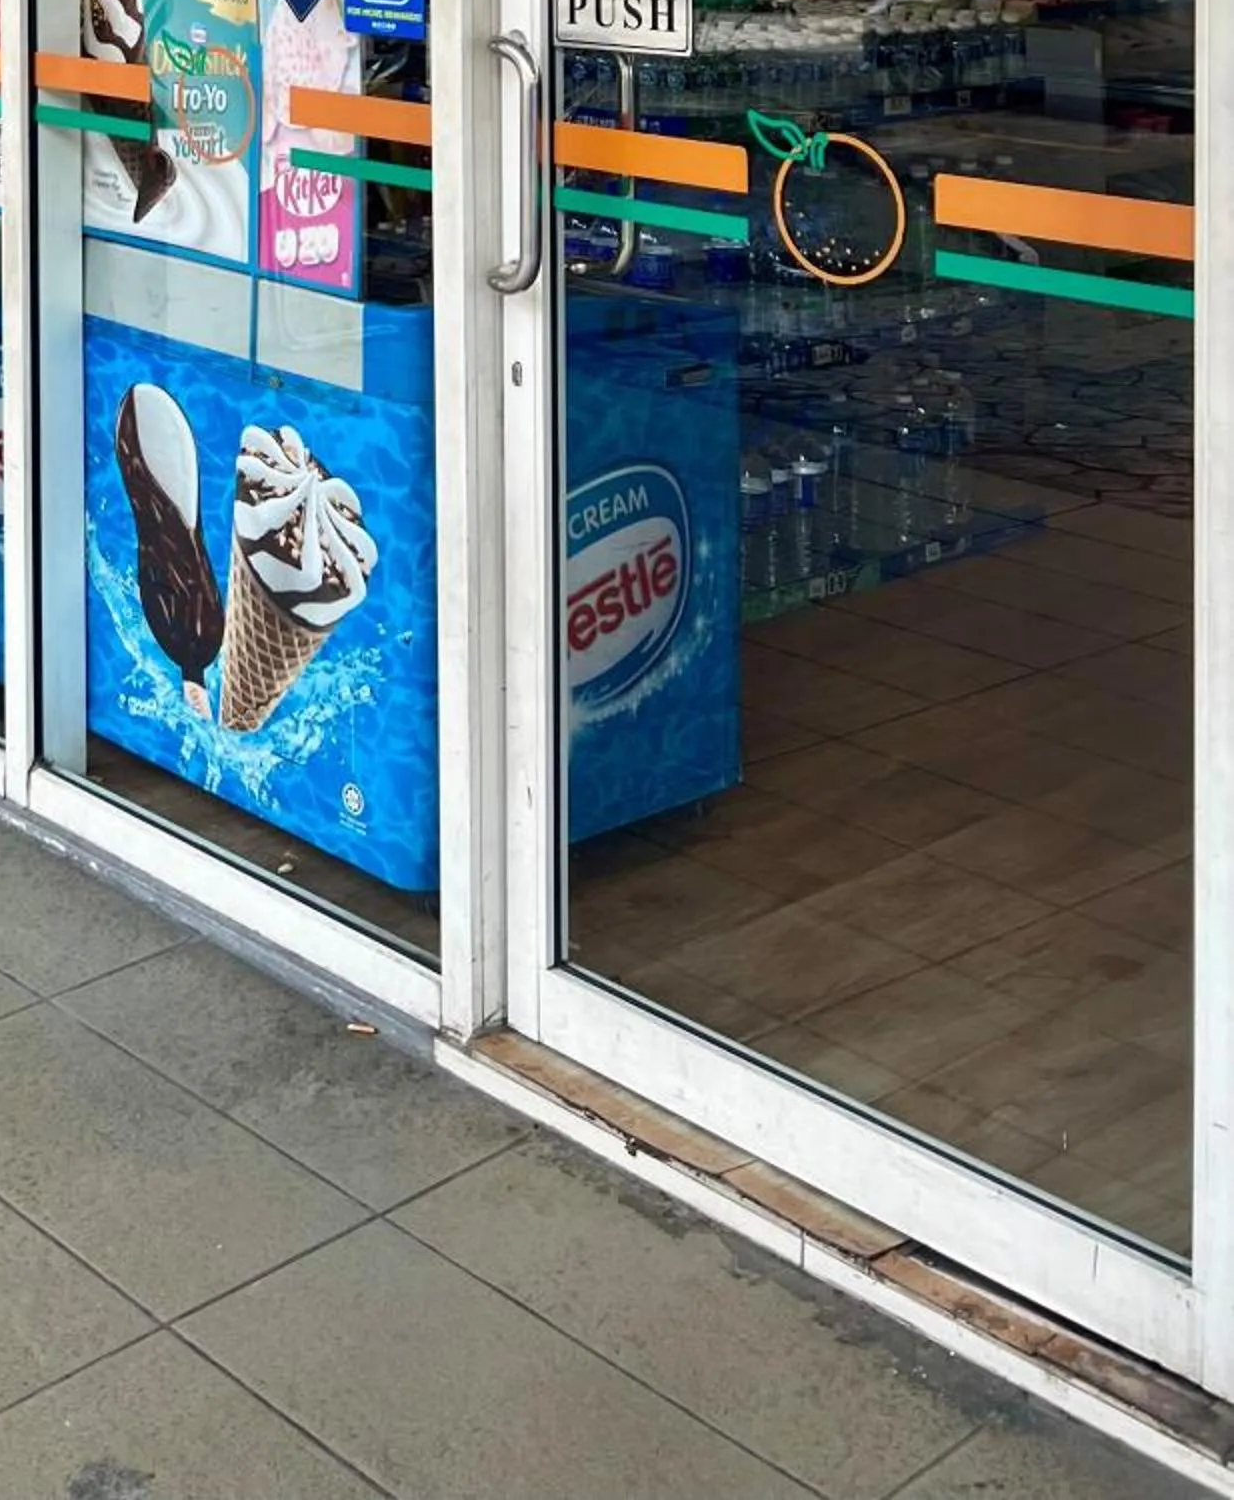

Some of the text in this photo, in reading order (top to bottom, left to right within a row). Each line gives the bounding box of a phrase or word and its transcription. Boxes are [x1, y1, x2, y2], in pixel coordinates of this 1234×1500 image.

[172, 131, 225, 165] Yogurt
[283, 168, 339, 215] KitKat
[568, 484, 649, 540] CREAM
